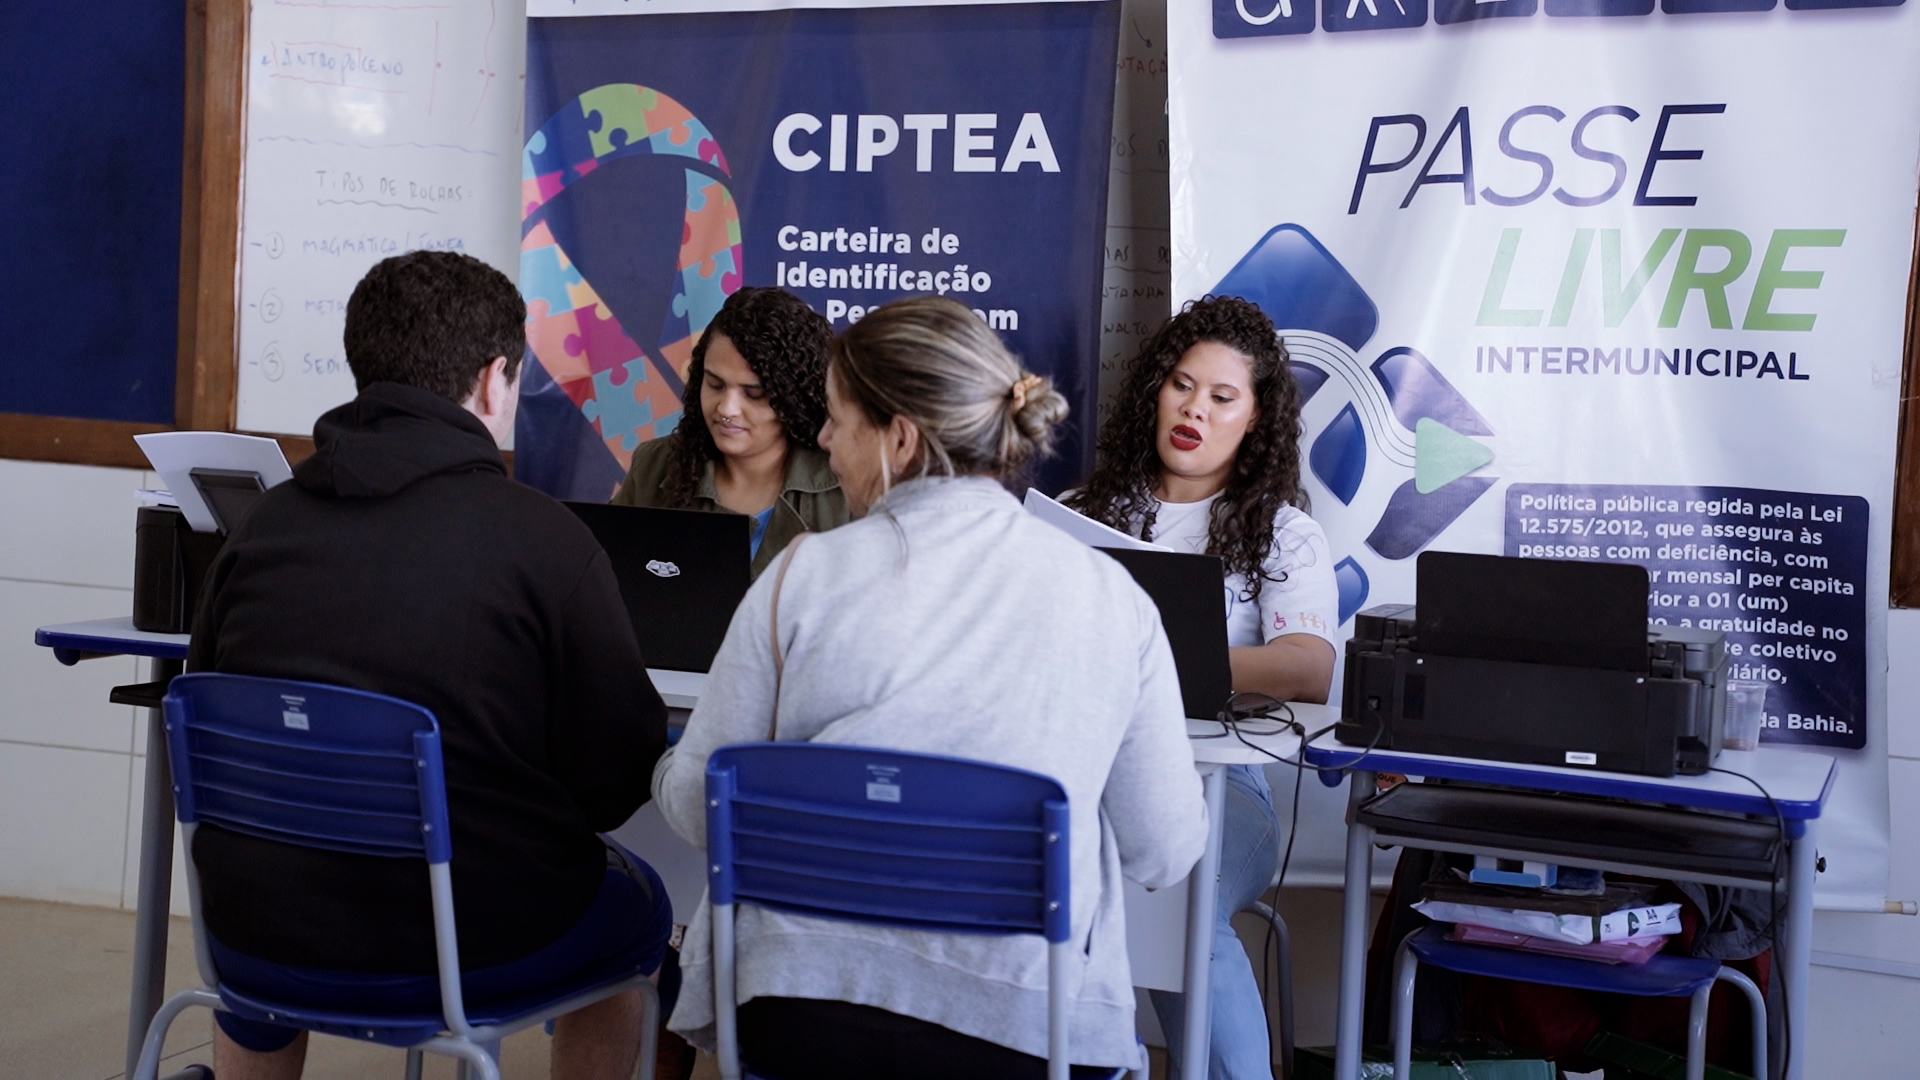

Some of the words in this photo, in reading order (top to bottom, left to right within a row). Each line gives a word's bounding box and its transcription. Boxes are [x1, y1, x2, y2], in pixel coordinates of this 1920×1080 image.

[772, 112, 1061, 172] CIPTEA
[1348, 103, 1727, 215] PASSE
[380, 177, 397, 197] DE
[777, 224, 912, 254] Carteira
[921, 228, 960, 254] de
[776, 261, 992, 296] Identificação
[1475, 228, 1848, 332] LIVRE
[1475, 346, 1810, 381] INTERMUNICIPAL
[1520, 494, 1597, 511] Política
[1603, 495, 1679, 514] pública
[1685, 498, 1754, 516] regida
[1760, 502, 1804, 519] pela
[1811, 505, 1843, 523] Lei
[1519, 517, 1649, 538] 12.575/2012,
[1655, 523, 1695, 539] que
[1701, 523, 1794, 541] assegura
[1800, 527, 1823, 545] às
[1518, 543, 1600, 558] pessoas
[1606, 545, 1650, 559] com
[1656, 543, 1778, 567] deficiência,
[1784, 552, 1829, 569] com
[1667, 568, 1742, 585] mensal
[1748, 573, 1784, 588] per
[1789, 577, 1855, 595] capita
[1687, 594, 1700, 607] a
[1706, 592, 1730, 608] 01
[1737, 593, 1789, 613] (um)
[1698, 617, 1816, 637] gratuidade
[1822, 626, 1849, 641] no
[1750, 641, 1837, 663] coletivo
[1787, 713, 1854, 734] Bahia.
